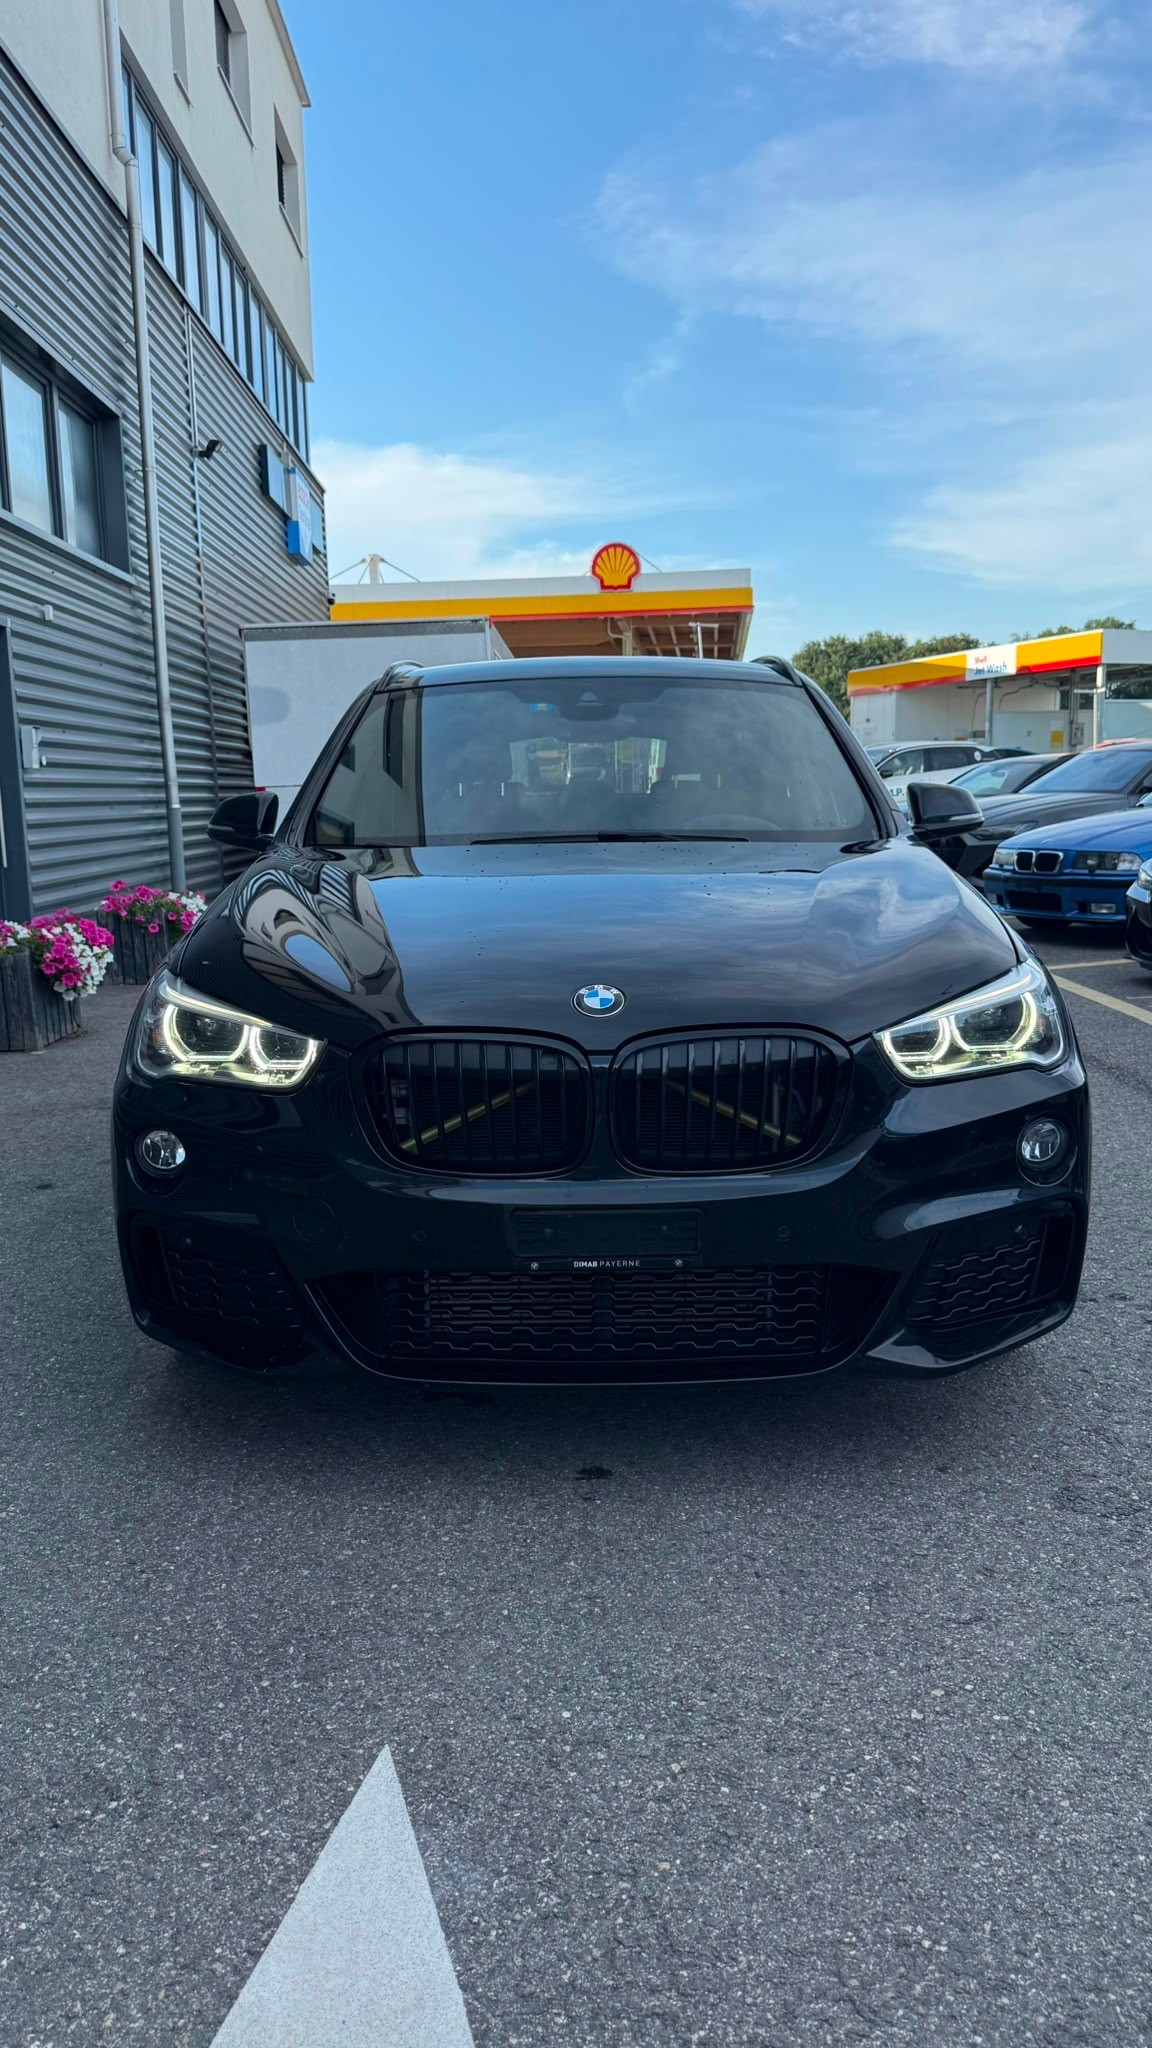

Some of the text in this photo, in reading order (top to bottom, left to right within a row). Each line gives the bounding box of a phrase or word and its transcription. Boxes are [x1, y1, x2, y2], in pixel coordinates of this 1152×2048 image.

[987, 660, 1008, 673] Wash
[579, 985, 621, 994] BMW
[573, 1259, 641, 1268] DIMAB PAYERNE
